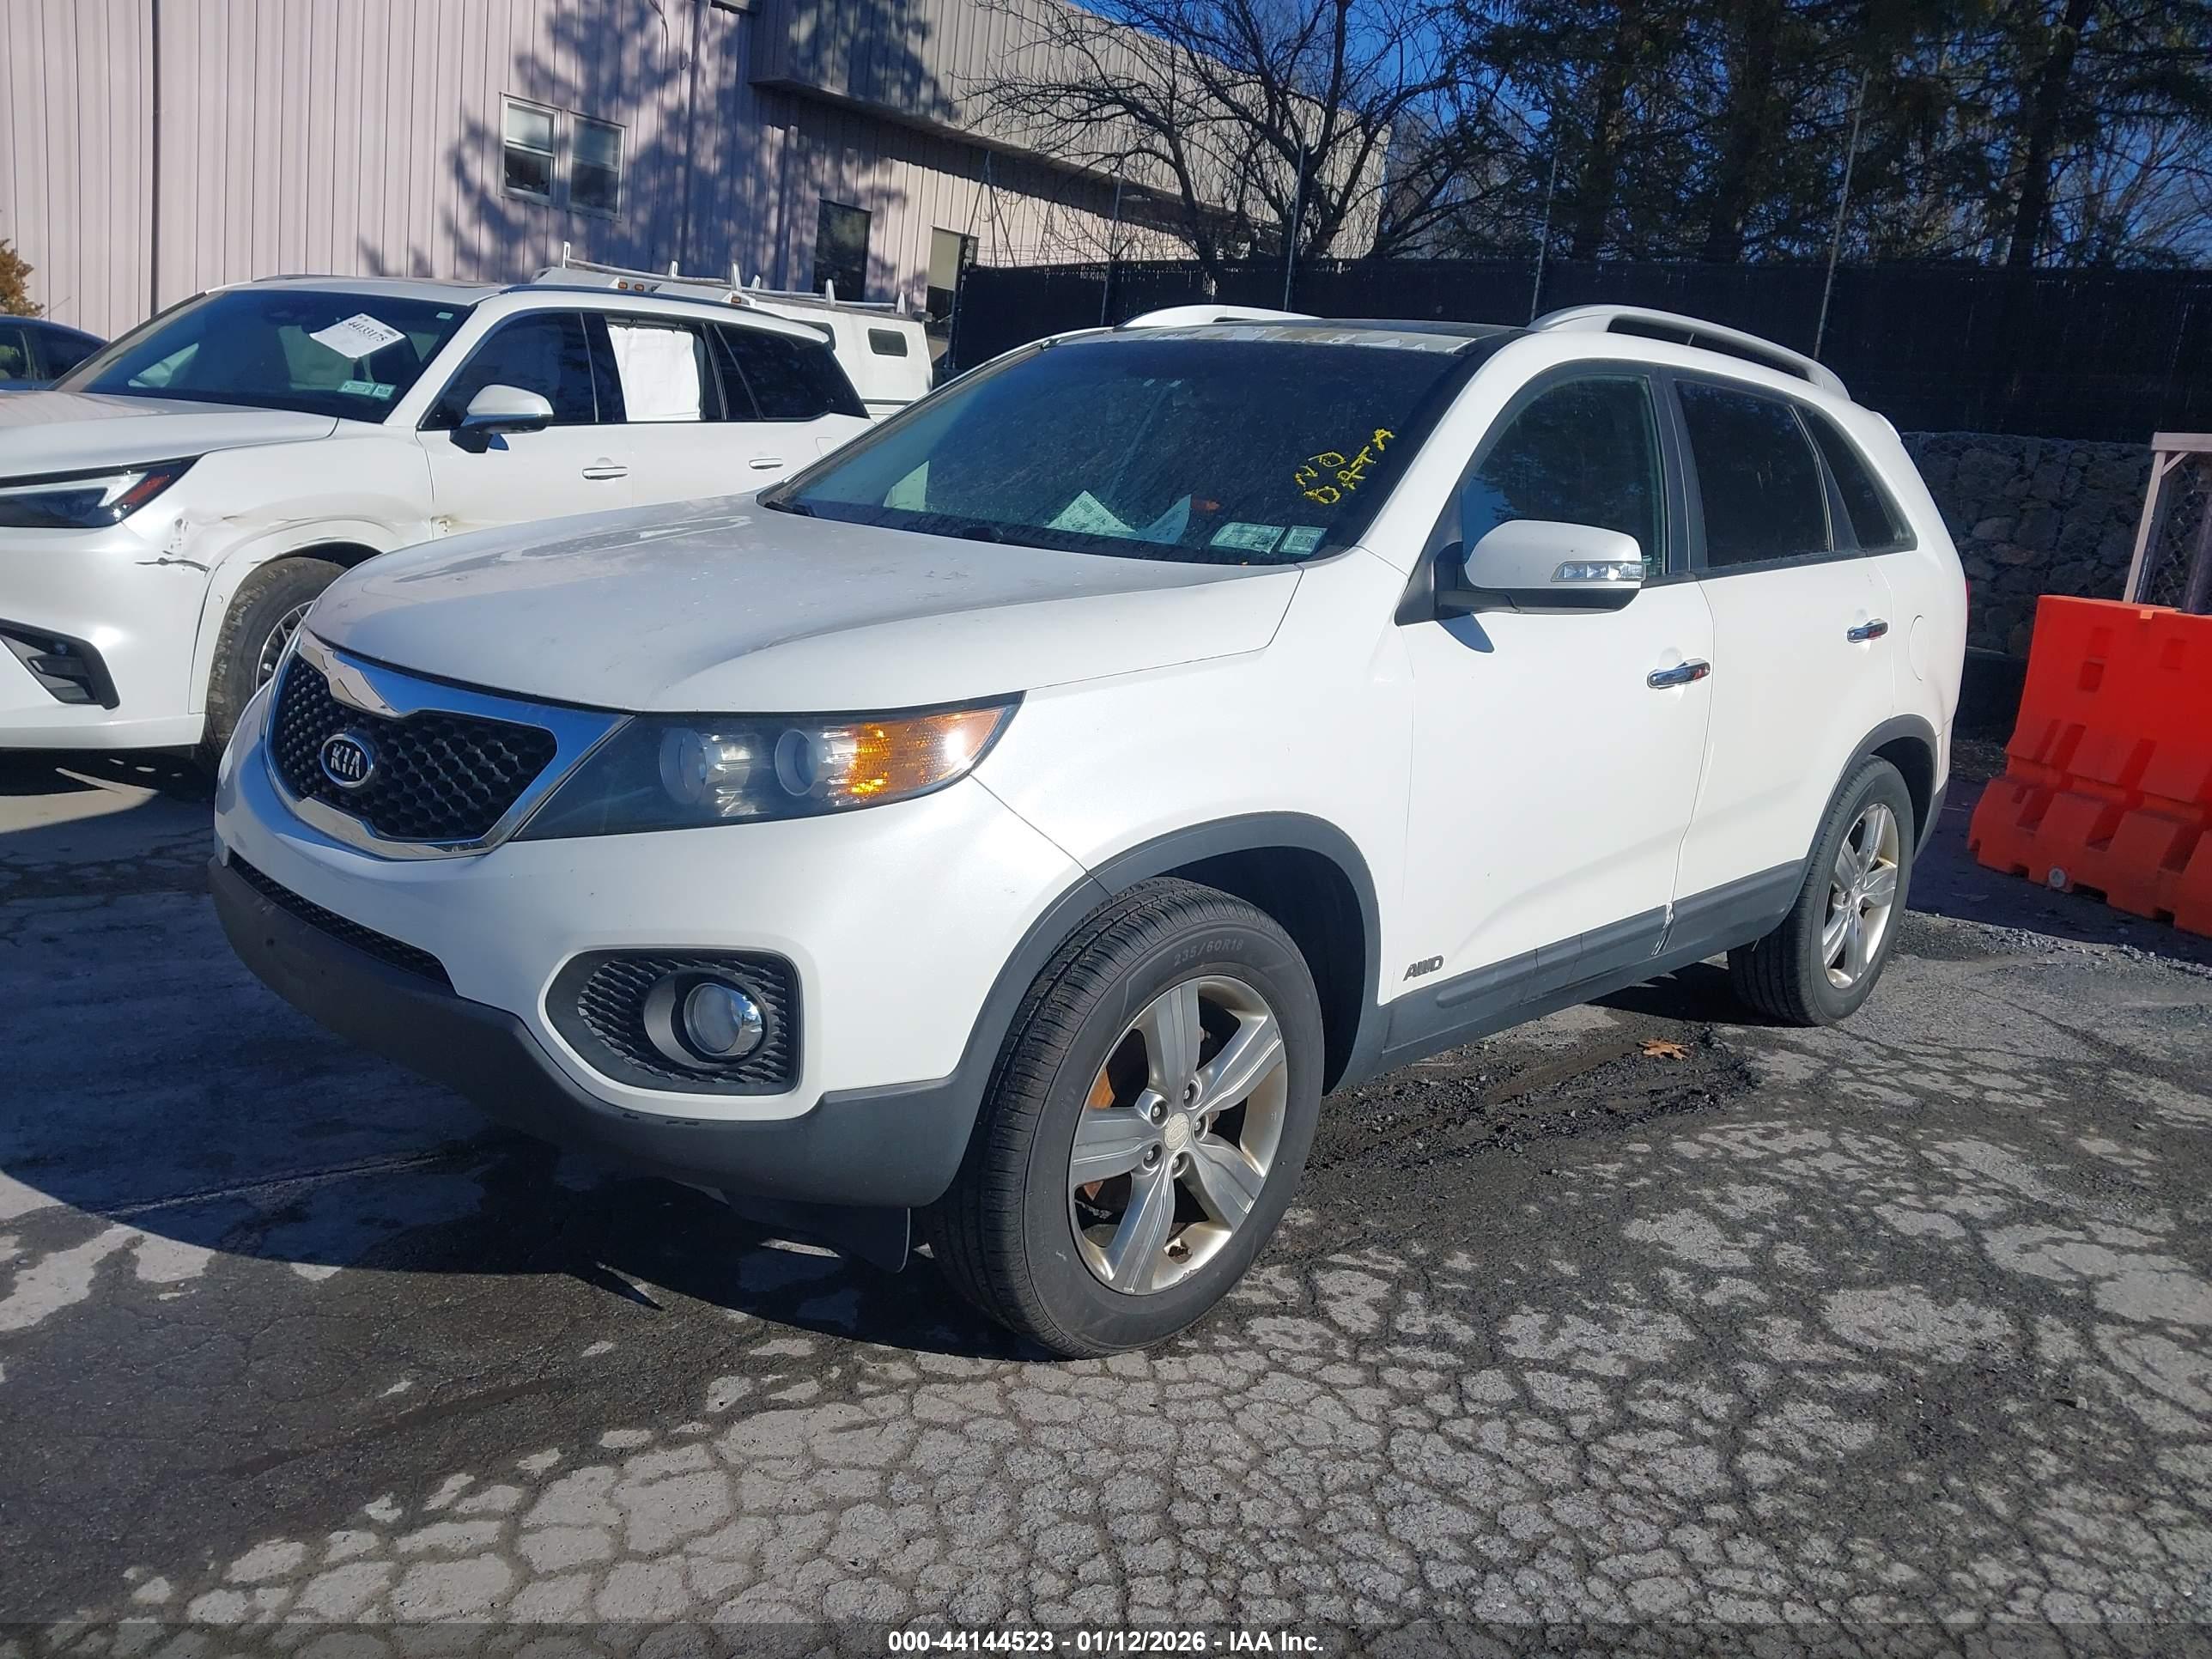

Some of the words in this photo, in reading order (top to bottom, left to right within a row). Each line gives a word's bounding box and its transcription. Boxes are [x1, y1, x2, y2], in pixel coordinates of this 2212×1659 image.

[331, 743, 361, 779] KIA
[1174, 939, 1244, 967] 235/60R18
[1402, 955, 1444, 981] AWD
